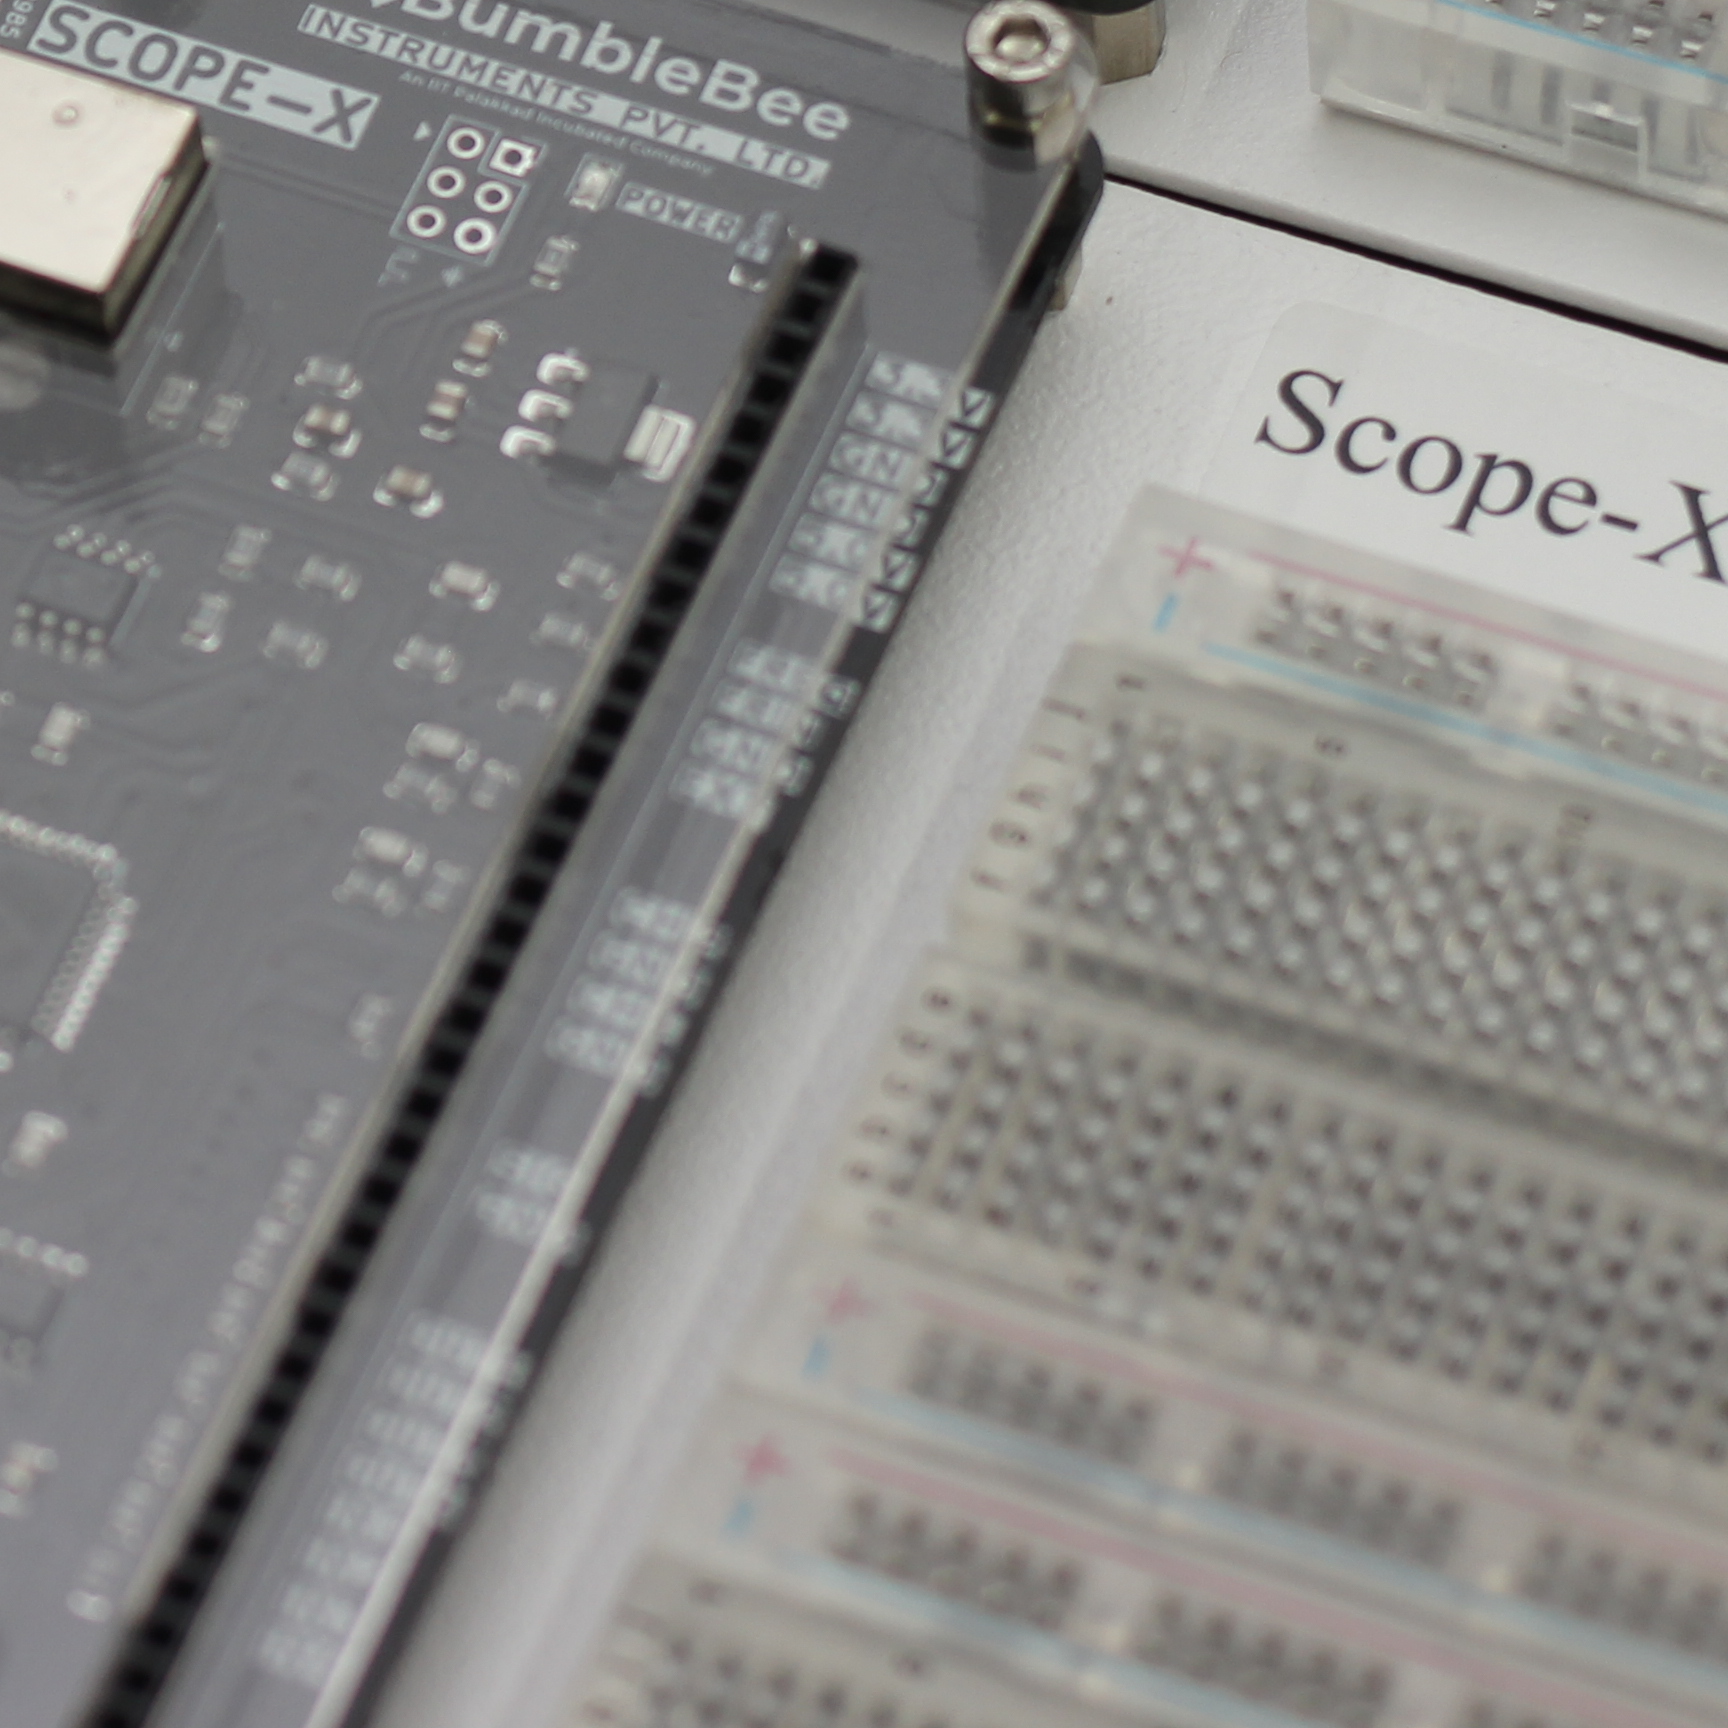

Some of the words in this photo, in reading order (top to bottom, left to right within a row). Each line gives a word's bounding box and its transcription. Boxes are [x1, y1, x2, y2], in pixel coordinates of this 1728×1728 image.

[302, 5, 599, 118] INSTRUMENTS
[618, 99, 712, 155] PVT.
[740, 138, 825, 186] LTD.
[399, 71, 424, 88] An
[452, 85, 535, 122] Palakkad
[537, 108, 628, 148] Incubated
[628, 136, 716, 178] Company
[620, 183, 739, 242] POWER
[1252, 366, 1728, 585] Scope-X
